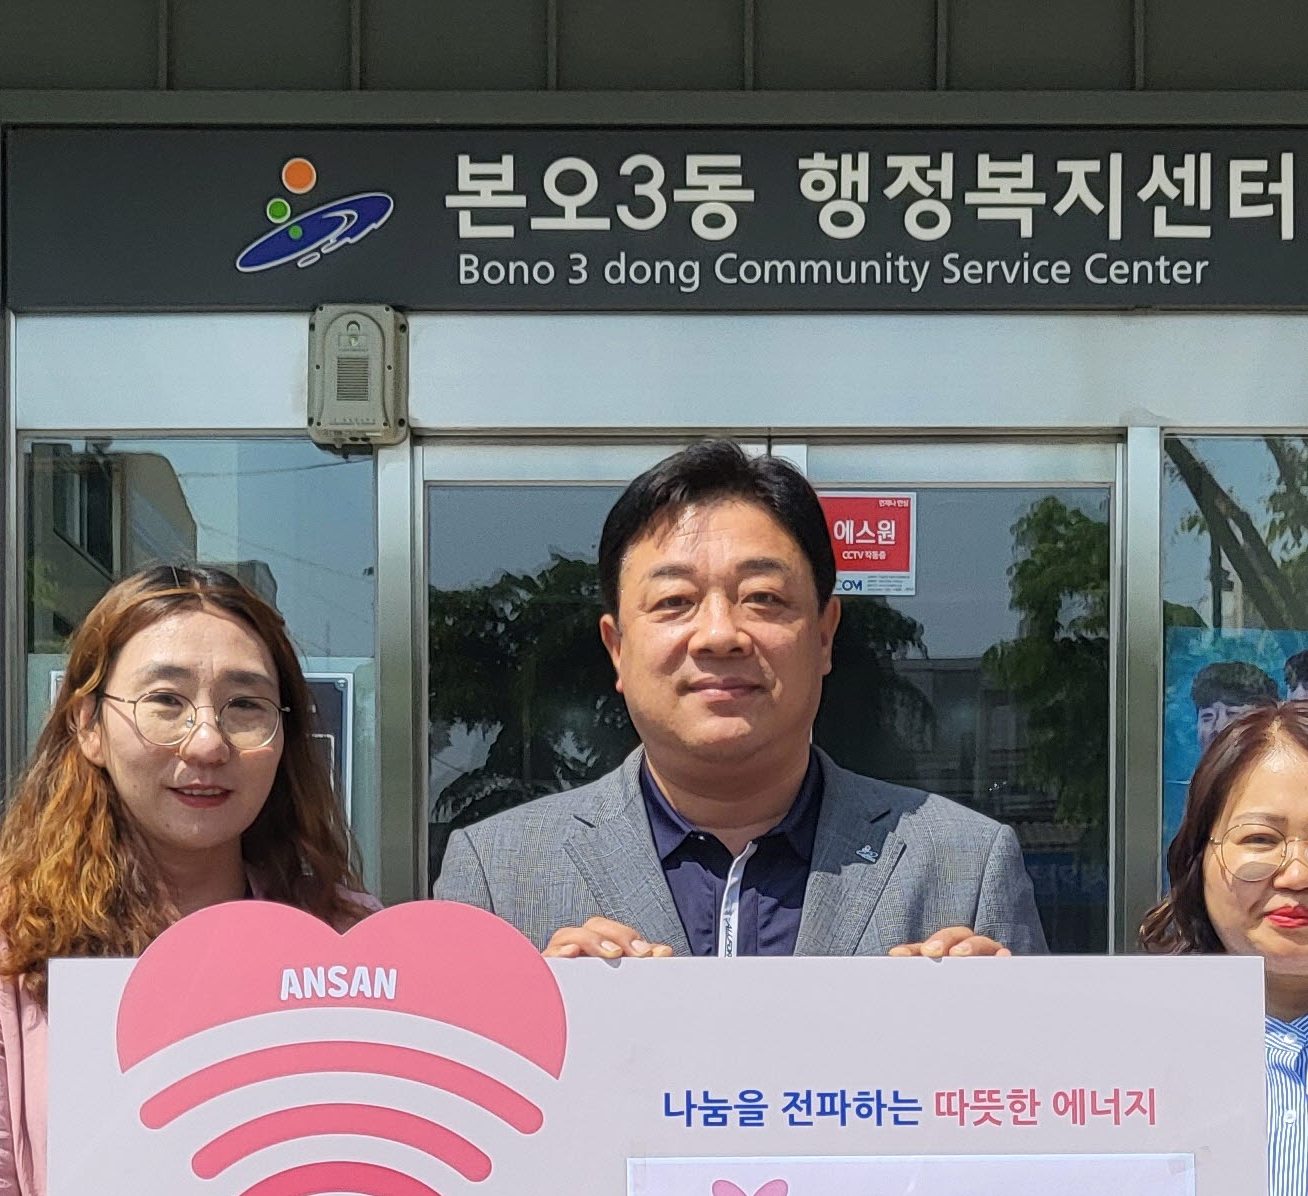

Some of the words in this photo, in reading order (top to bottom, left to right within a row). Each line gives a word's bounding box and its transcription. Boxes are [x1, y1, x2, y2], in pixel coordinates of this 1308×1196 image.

[445, 152, 755, 241] 본오3동
[796, 151, 1297, 241] 행정복지센터
[459, 254, 555, 286] Bono
[567, 254, 589, 286] 3
[602, 252, 701, 294] dong
[714, 253, 929, 294] Community
[942, 252, 1071, 286] Service
[1082, 254, 1208, 286] Center
[833, 519, 896, 545] 에스원
[842, 551, 864, 560] CCTV
[280, 965, 398, 1001] ANSAN
[663, 1090, 769, 1128] 나눔을
[781, 1089, 922, 1128] 전파하는
[934, 1088, 1041, 1127] 따뜻한
[1052, 1087, 1158, 1127] 에너지
